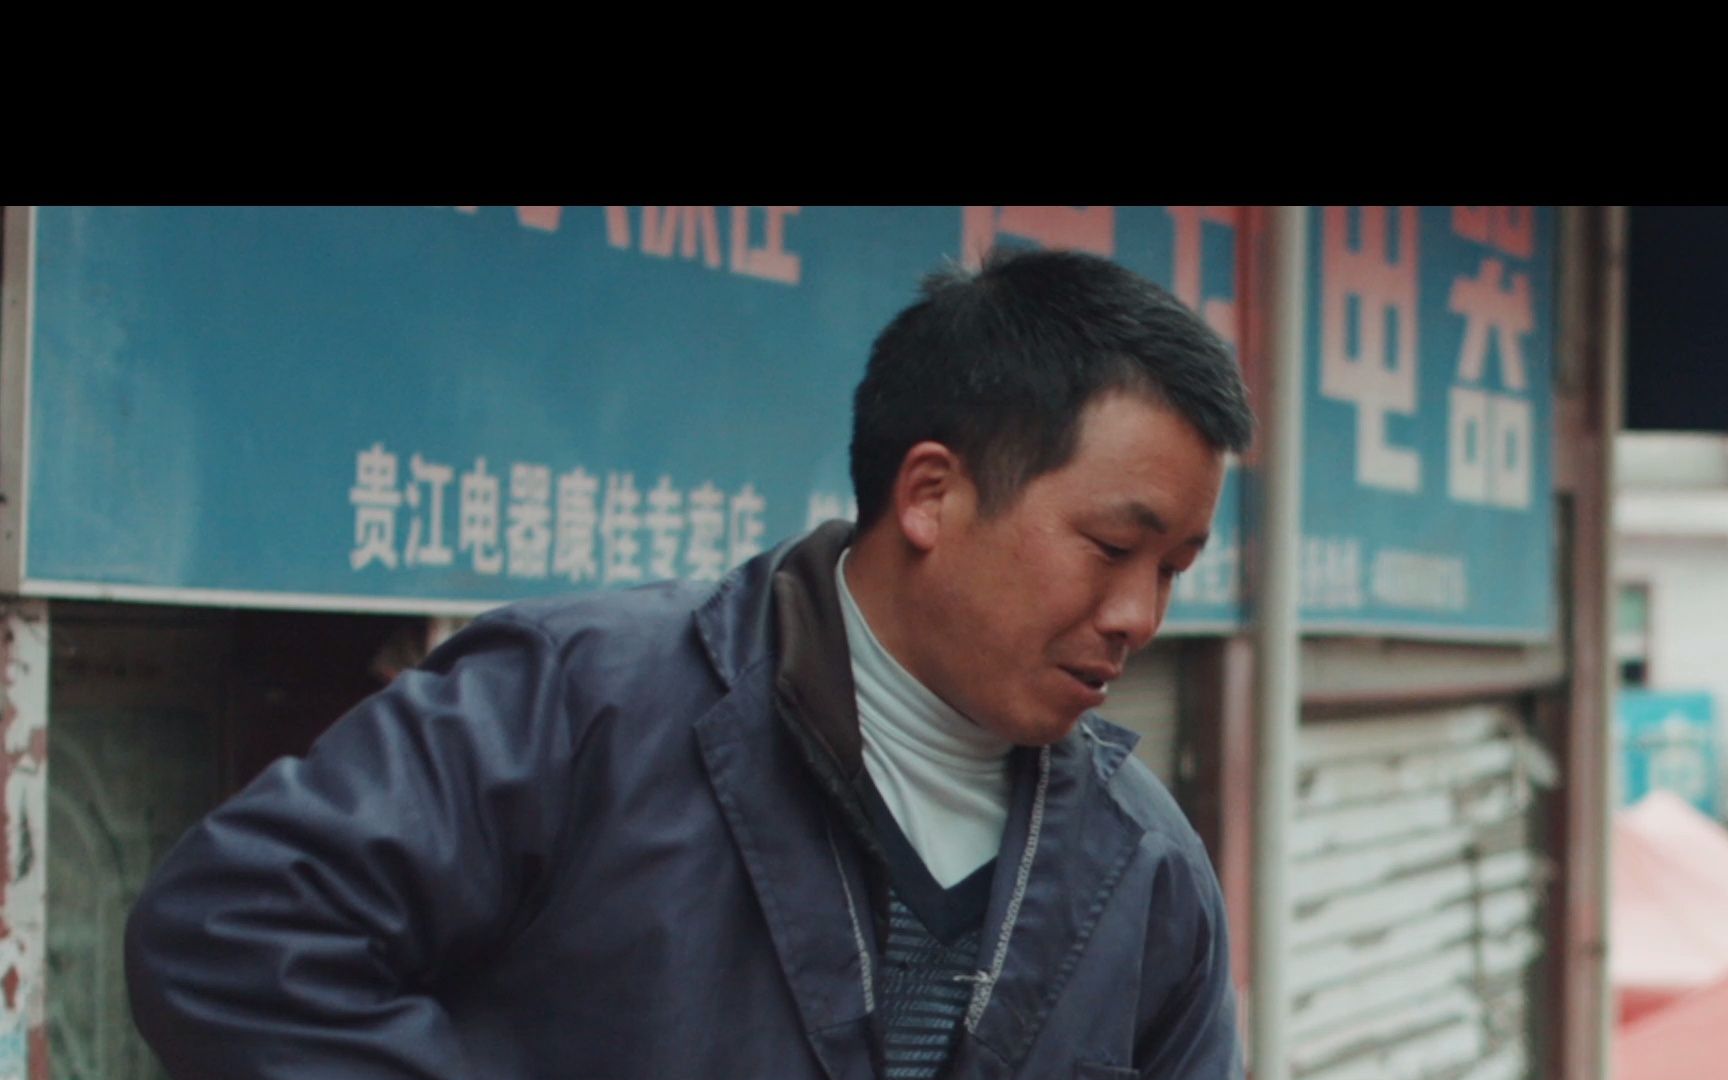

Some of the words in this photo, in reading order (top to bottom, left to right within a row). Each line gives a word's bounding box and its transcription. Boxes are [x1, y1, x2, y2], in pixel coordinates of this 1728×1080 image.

[348, 441, 768, 584] 贵江电器康佳专卖店
